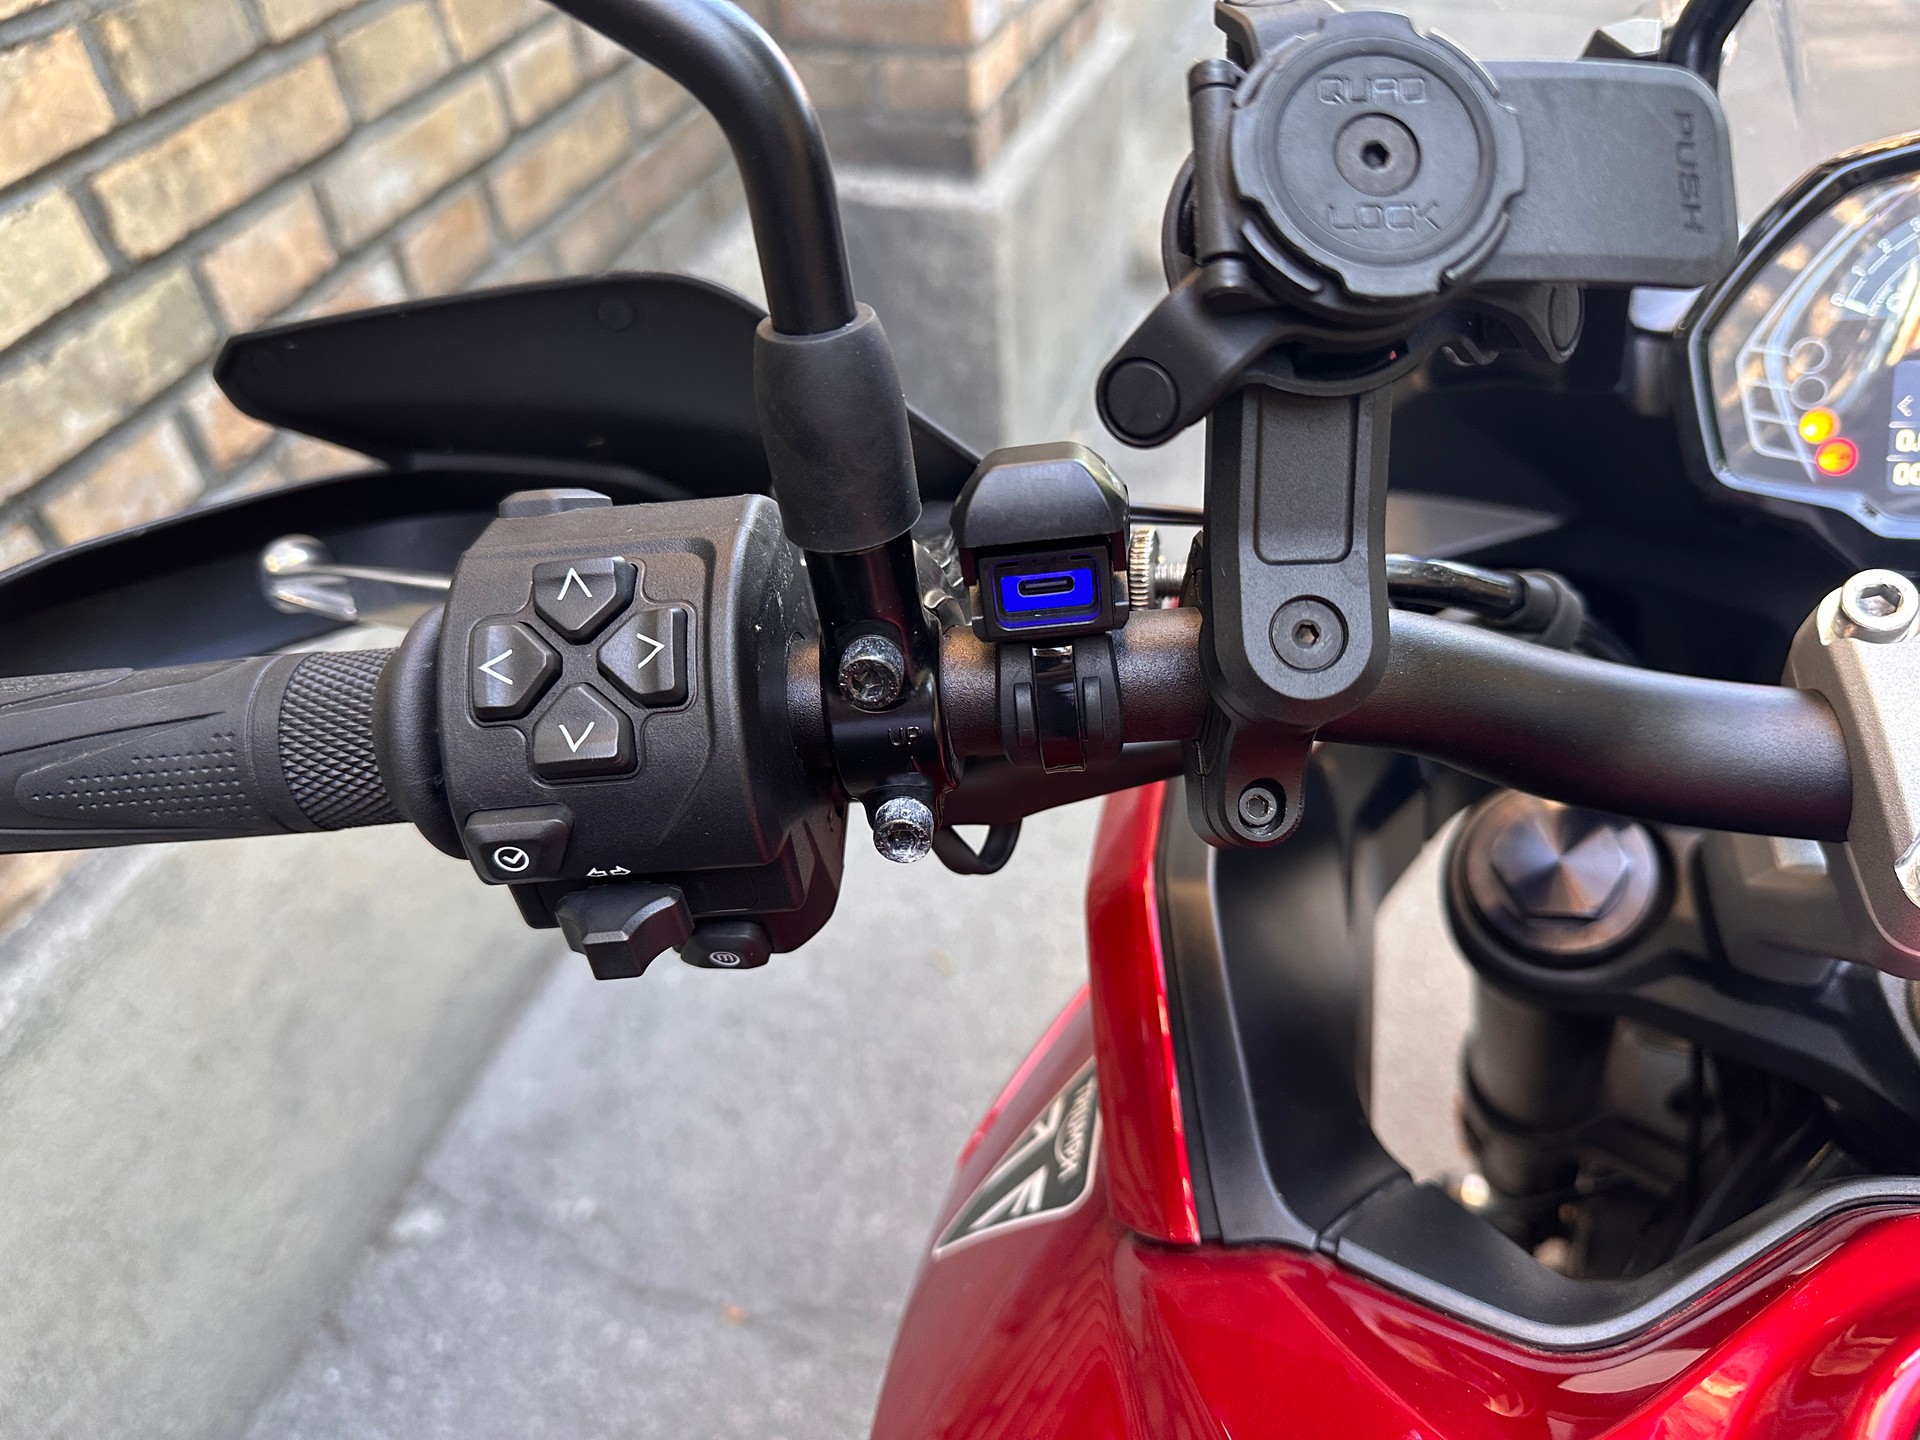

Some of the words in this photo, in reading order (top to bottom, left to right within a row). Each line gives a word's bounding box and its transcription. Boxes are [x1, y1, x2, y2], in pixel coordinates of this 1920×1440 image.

[1317, 76, 1428, 105] QUAD
[1673, 110, 1704, 233] PUSH
[1327, 202, 1441, 232] LOCK
[888, 726, 922, 746] UP
[1055, 1077, 1098, 1183] TRIUMPH
